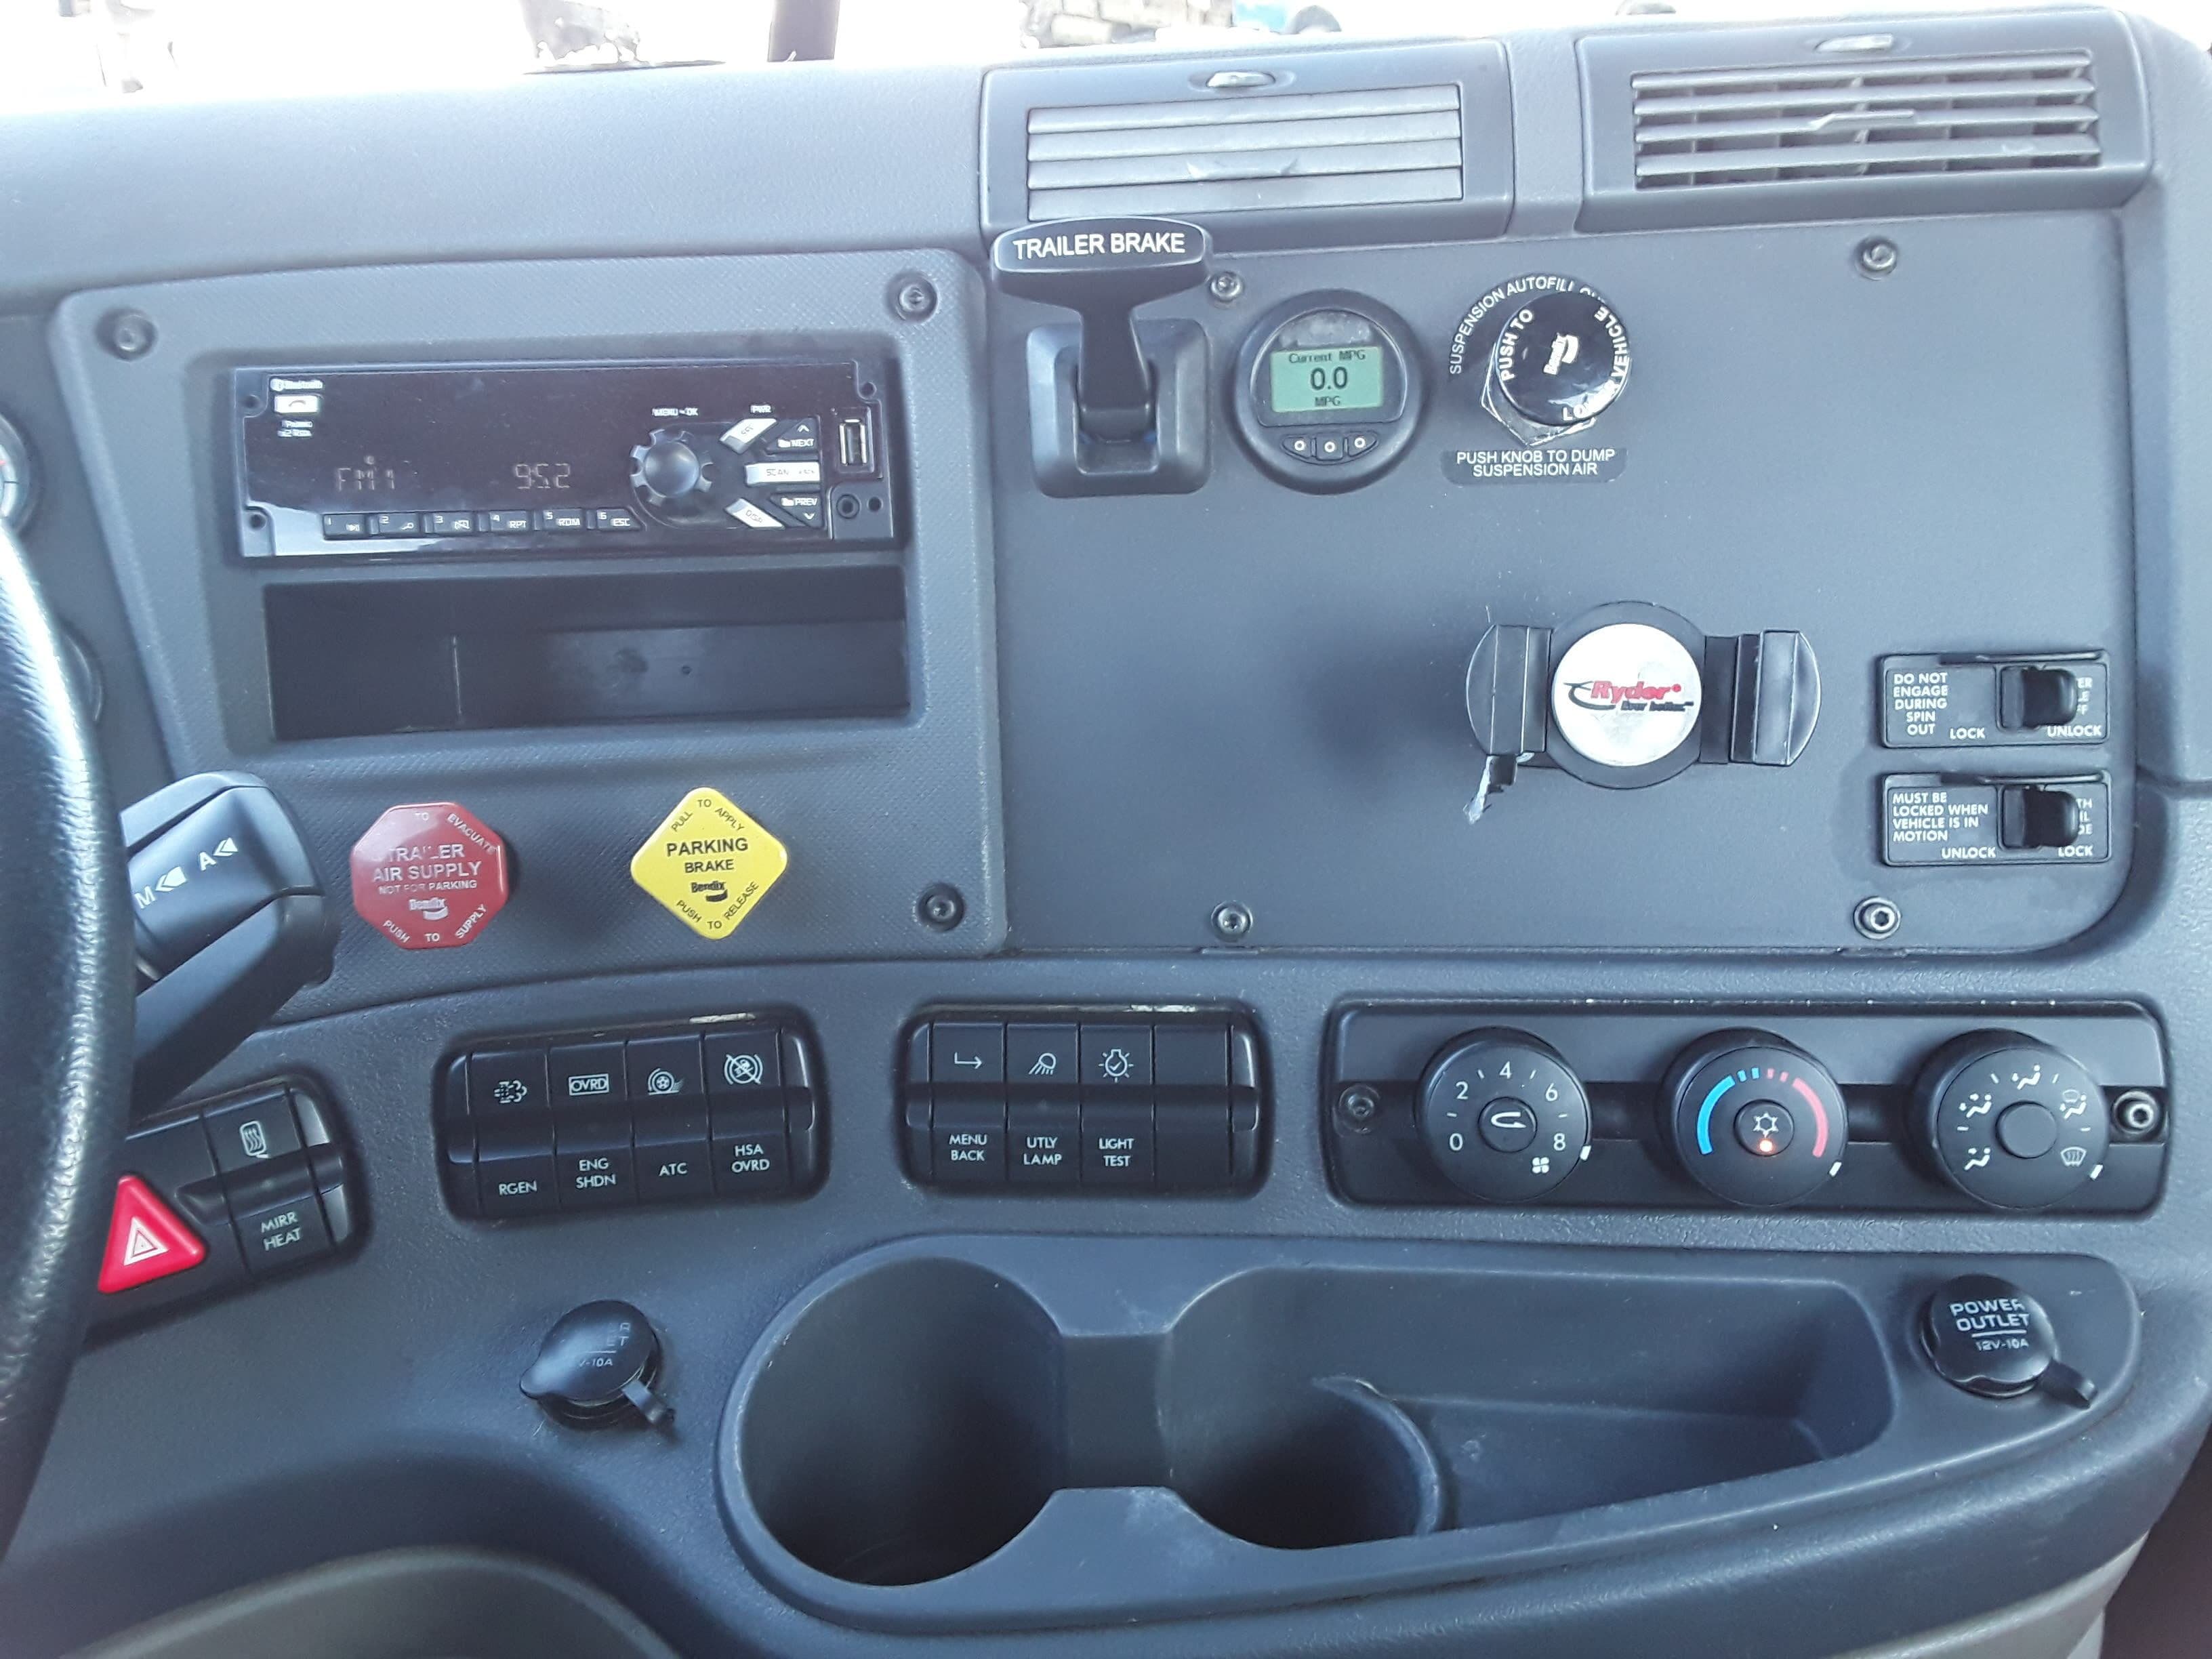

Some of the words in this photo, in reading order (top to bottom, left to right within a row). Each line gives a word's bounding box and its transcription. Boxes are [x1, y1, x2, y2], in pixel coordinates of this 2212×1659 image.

[1013, 235, 1106, 260] TRAILER
[1111, 232, 1186, 254] BRAKE
[1449, 289, 1506, 375] SUSPENSION
[1498, 332, 1518, 381] PUSH
[1510, 309, 1533, 329] TO
[1595, 306, 1629, 377] VEHICLE
[1289, 353, 1332, 364] Current
[1338, 350, 1366, 361] MPG
[1311, 367, 1348, 390] 0.0
[1315, 396, 1340, 407] MPG
[791, 438, 815, 447] NEXT
[1457, 451, 1496, 464] PUSH
[1501, 450, 1543, 464] KNOB
[1547, 449, 1567, 462] TO
[1572, 449, 1615, 462] DUMP
[1473, 462, 1570, 477] SUSPENSION
[1572, 462, 1598, 475] AIR
[795, 497, 817, 506] PREV
[509, 520, 527, 529] RPT
[611, 518, 631, 527] ESC
[1893, 673, 1914, 684] DO
[1919, 672, 1948, 683] NOT
[1893, 685, 1948, 697] ENGAGE
[1895, 698, 1947, 710] DURING
[1906, 711, 1936, 722] SPIN
[1907, 724, 1935, 735] OUT
[1949, 728, 1985, 739] LOCK
[2047, 725, 2102, 737] UNLOCK
[1893, 793, 1928, 804] MUST
[1932, 792, 1947, 803] BE
[672, 812, 693, 832] PULL
[697, 799, 712, 808] TO
[715, 807, 745, 832] APPLY
[1893, 805, 1944, 817] LOCKED
[1948, 804, 1988, 815] WHEN
[1893, 817, 1944, 829] VEHICLE
[1948, 817, 1961, 827] IS
[1964, 817, 1979, 827] IN
[1893, 830, 1948, 842] MOTION
[666, 838, 749, 857] PARKING
[1941, 847, 1996, 859] UNLOCK
[2058, 845, 2093, 857] LOCK
[198, 851, 217, 871] A
[684, 859, 735, 874] BRAKE
[373, 867, 403, 882] AIR
[409, 861, 482, 878] SUPPLY
[379, 885, 401, 895] NOT
[429, 880, 477, 890] PARKING
[134, 885, 156, 909] M
[676, 899, 702, 922] PUSH
[708, 920, 722, 929] TO
[724, 881, 759, 920] RELEASE
[383, 920, 410, 943] PUSH
[425, 933, 440, 941] TO
[455, 903, 487, 939] SUPPLY
[1499, 1061, 1512, 1079] 4
[571, 1078, 608, 1092] OVRD
[1456, 1082, 1469, 1100] 2
[1545, 1083, 1558, 1101] 6
[949, 1134, 987, 1146] MENU
[1027, 1136, 1057, 1149] UTLY
[1099, 1138, 1134, 1150] LIGHT
[1449, 1133, 1463, 1151] 0
[1553, 1133, 1565, 1151] 8
[735, 1143, 763, 1156] HSA
[951, 1150, 985, 1162] BACK
[579, 1158, 609, 1171] ENG
[731, 1159, 770, 1173] OVRD
[1023, 1153, 1062, 1166] LAMP
[1103, 1155, 1131, 1167] TEST
[659, 1162, 688, 1176] ATC
[499, 1180, 537, 1195] RGEN
[575, 1173, 616, 1189] SHDN
[261, 1211, 298, 1233] MIRR
[264, 1228, 302, 1251] HEAT
[1950, 1298, 2026, 1317] POWER
[1956, 1313, 2030, 1332] OUTLET
